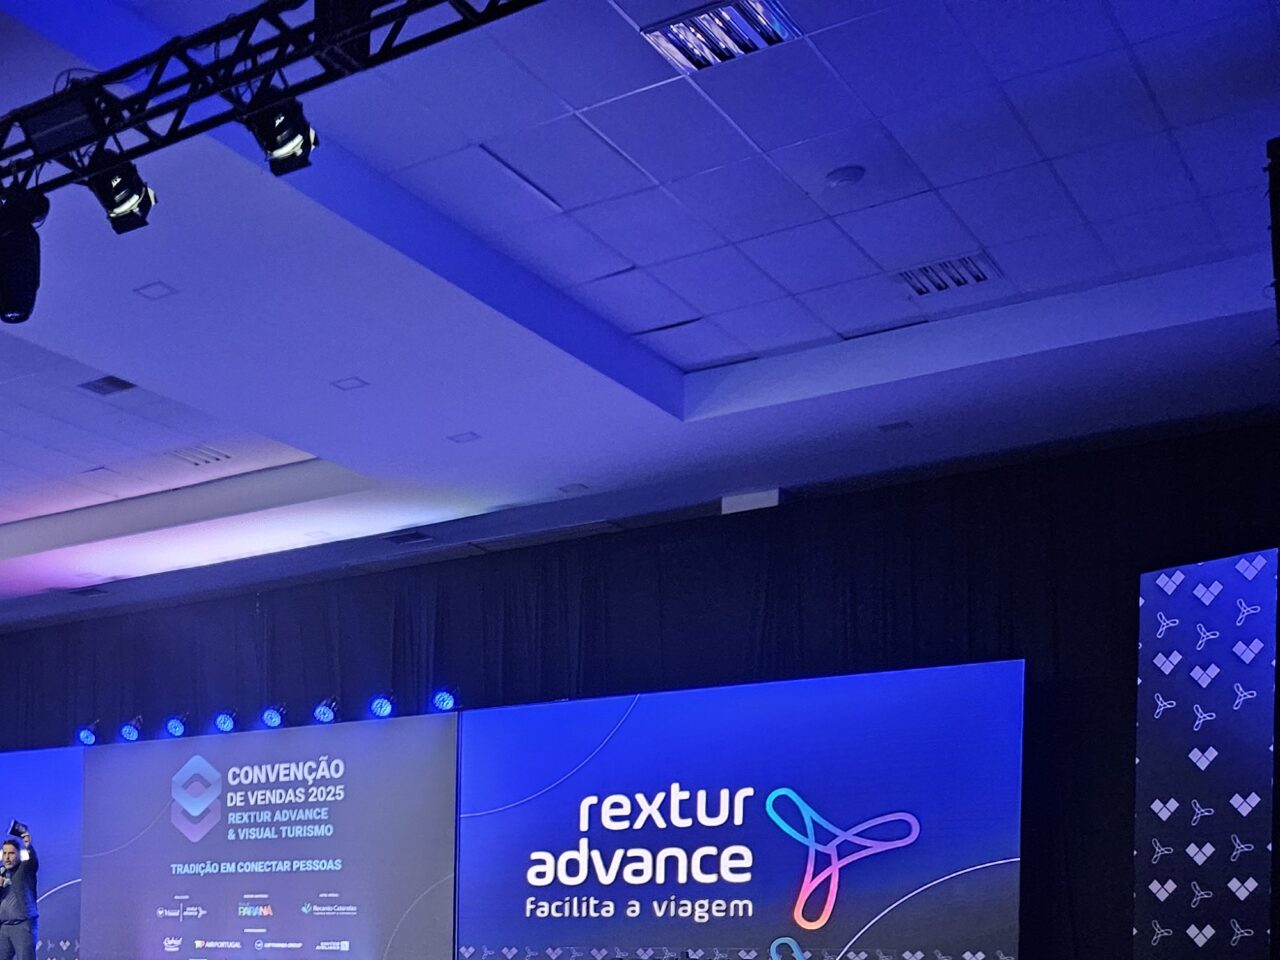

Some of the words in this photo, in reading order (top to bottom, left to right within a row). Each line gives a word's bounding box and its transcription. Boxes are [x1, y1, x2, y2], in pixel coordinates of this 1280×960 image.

[227, 756, 345, 785] CONVENÇÃO
[226, 792, 245, 807] DE
[248, 788, 306, 805] VENDAS
[308, 785, 345, 802] 2025
[579, 782, 755, 832] rextur
[228, 811, 271, 824] REXTUR
[274, 808, 328, 822] ADVANCE
[227, 828, 236, 841] &
[238, 826, 278, 840] VISUAL
[279, 824, 334, 838] TURISMO
[171, 861, 220, 876] TRADIÇÃO
[220, 862, 236, 873] EM
[237, 861, 291, 873] CONECTAR
[293, 859, 342, 872] PESSOAS
[526, 837, 753, 887] advance
[525, 896, 615, 918] facilita
[626, 899, 641, 917] a
[652, 895, 753, 923] viagem
